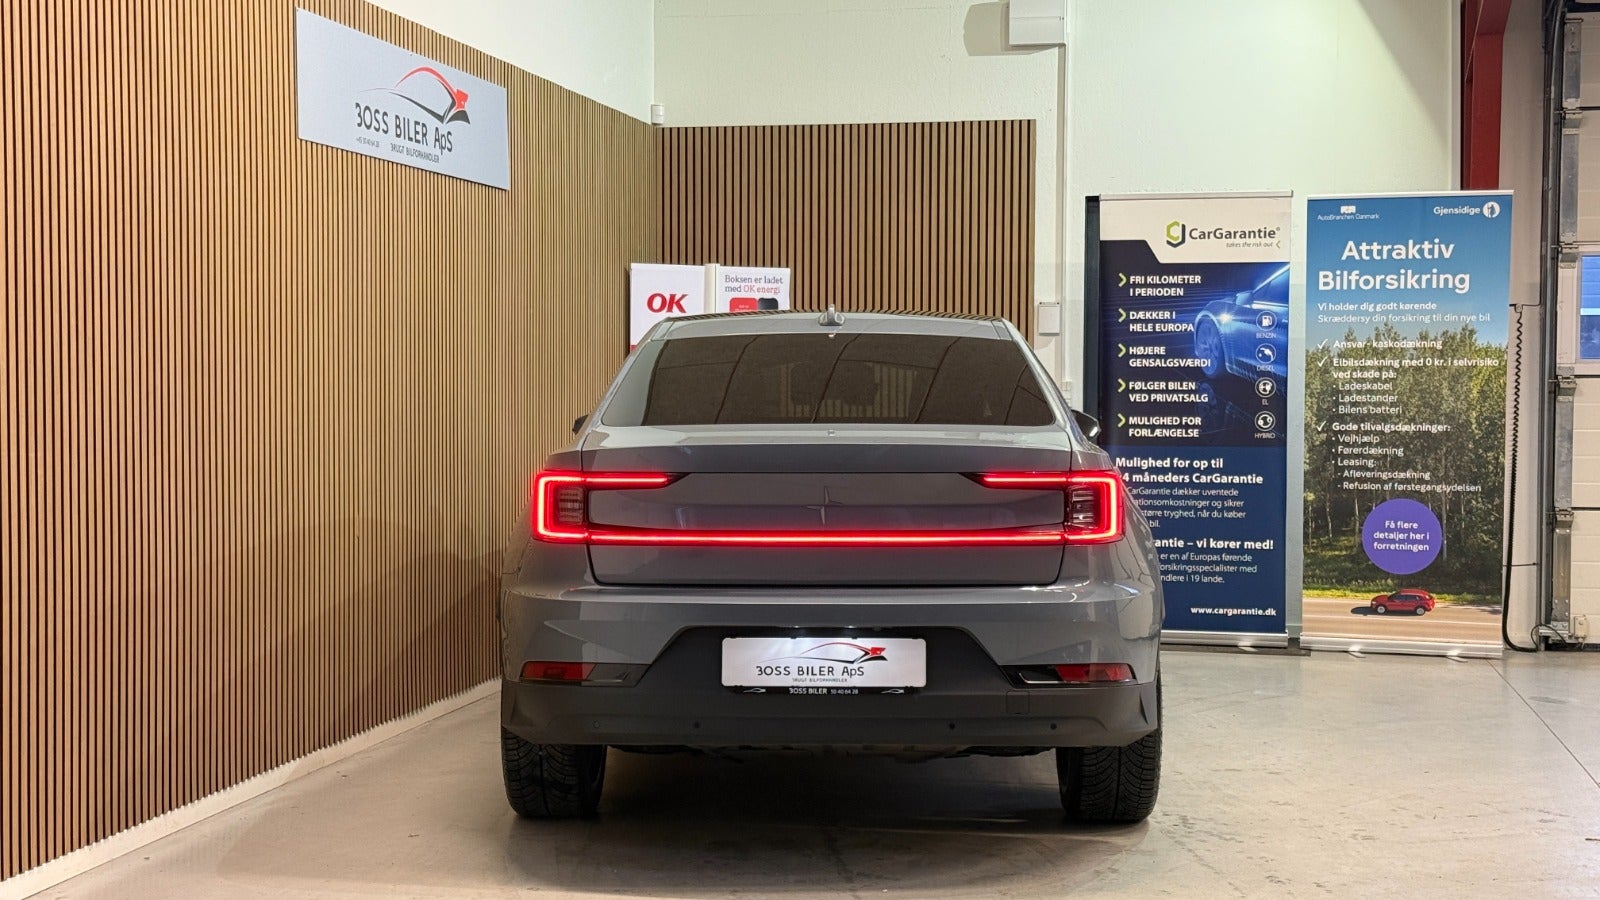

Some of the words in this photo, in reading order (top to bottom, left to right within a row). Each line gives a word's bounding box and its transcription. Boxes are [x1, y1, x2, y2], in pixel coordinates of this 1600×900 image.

[394, 115, 428, 146] BILER
[434, 127, 453, 156] ApS
[1434, 206, 1480, 216] Gjensidige
[1341, 238, 1455, 260] Attraktiv
[725, 275, 752, 283] Boksen
[764, 276, 783, 284] ladet
[1130, 276, 1144, 284] FRI
[1147, 276, 1201, 284] KILOMETER
[1318, 269, 1470, 294] Bilforsikring
[757, 286, 780, 294] energi
[646, 293, 688, 313] OK
[1360, 303, 1374, 312] dig
[1376, 302, 1397, 312] godt
[1400, 302, 1437, 310] kørende
[1318, 314, 1370, 324] Skræddersy
[1372, 314, 1386, 322] din
[1388, 314, 1430, 323] forsikring
[1432, 314, 1442, 322] til
[1444, 314, 1458, 322] din
[1460, 315, 1476, 323] nye
[1130, 324, 1153, 332] HELE
[1155, 324, 1194, 332] EUROPA
[1373, 340, 1442, 349] kaskodækning
[1129, 346, 1166, 355] HØJERE
[1129, 359, 1211, 367] GENSALGSVÆRDI
[1333, 358, 1400, 368] Elbilsdækning
[1402, 358, 1423, 366] med
[1453, 358, 1499, 366] selvrisiko
[1333, 370, 1350, 378] ved
[1352, 370, 1380, 378] skade
[1382, 370, 1396, 379] på:
[1129, 382, 1166, 390] FØLGER
[1151, 394, 1208, 402] PRIVATSALG
[1339, 406, 1368, 414] Bilens
[1370, 406, 1402, 414] batteri
[1129, 417, 1180, 425] MULIGHED
[1360, 423, 1451, 432] tilvalgsdækninger:
[1129, 429, 1199, 437] FORLÆNGELSE
[1338, 435, 1379, 443] Vejhjælp
[1338, 447, 1404, 456] Førerdækning
[1116, 457, 1170, 469] Mulighed
[1173, 458, 1189, 468] for
[1192, 460, 1208, 471] op
[1211, 458, 1223, 468] til
[1338, 458, 1376, 467] Leasing:
[1132, 472, 1189, 483] måneders
[1192, 474, 1263, 484] CarGarantie
[1343, 471, 1430, 480] Afleveringsdækning
[1343, 482, 1381, 490] Refusion
[1383, 482, 1392, 491] af
[1394, 483, 1481, 492] førstegangsydelsen
[1127, 487, 1170, 495] CarGarantie
[1172, 488, 1200, 496] dækker
[1202, 488, 1238, 497] uventede
[1136, 499, 1210, 508] tionsomkostninger
[1211, 500, 1222, 508] og
[1224, 499, 1244, 507] sikrer
[1164, 510, 1196, 519] tryghed,
[1374, 532, 1408, 540] detaljer
[1154, 538, 1184, 547] antie
[1196, 538, 1206, 548] vi
[1210, 539, 1242, 549] kører
[1244, 540, 1273, 549] med!
[1374, 542, 1429, 552] forretningen
[1181, 552, 1190, 560] af
[1190, 553, 1220, 562] Europas
[1222, 553, 1252, 561] førende
[1159, 563, 1237, 573] orsikringsspecialister
[1191, 607, 1277, 616] www.cargarantie.dk
[798, 666, 834, 676] BILER
[842, 666, 864, 678] ApS
